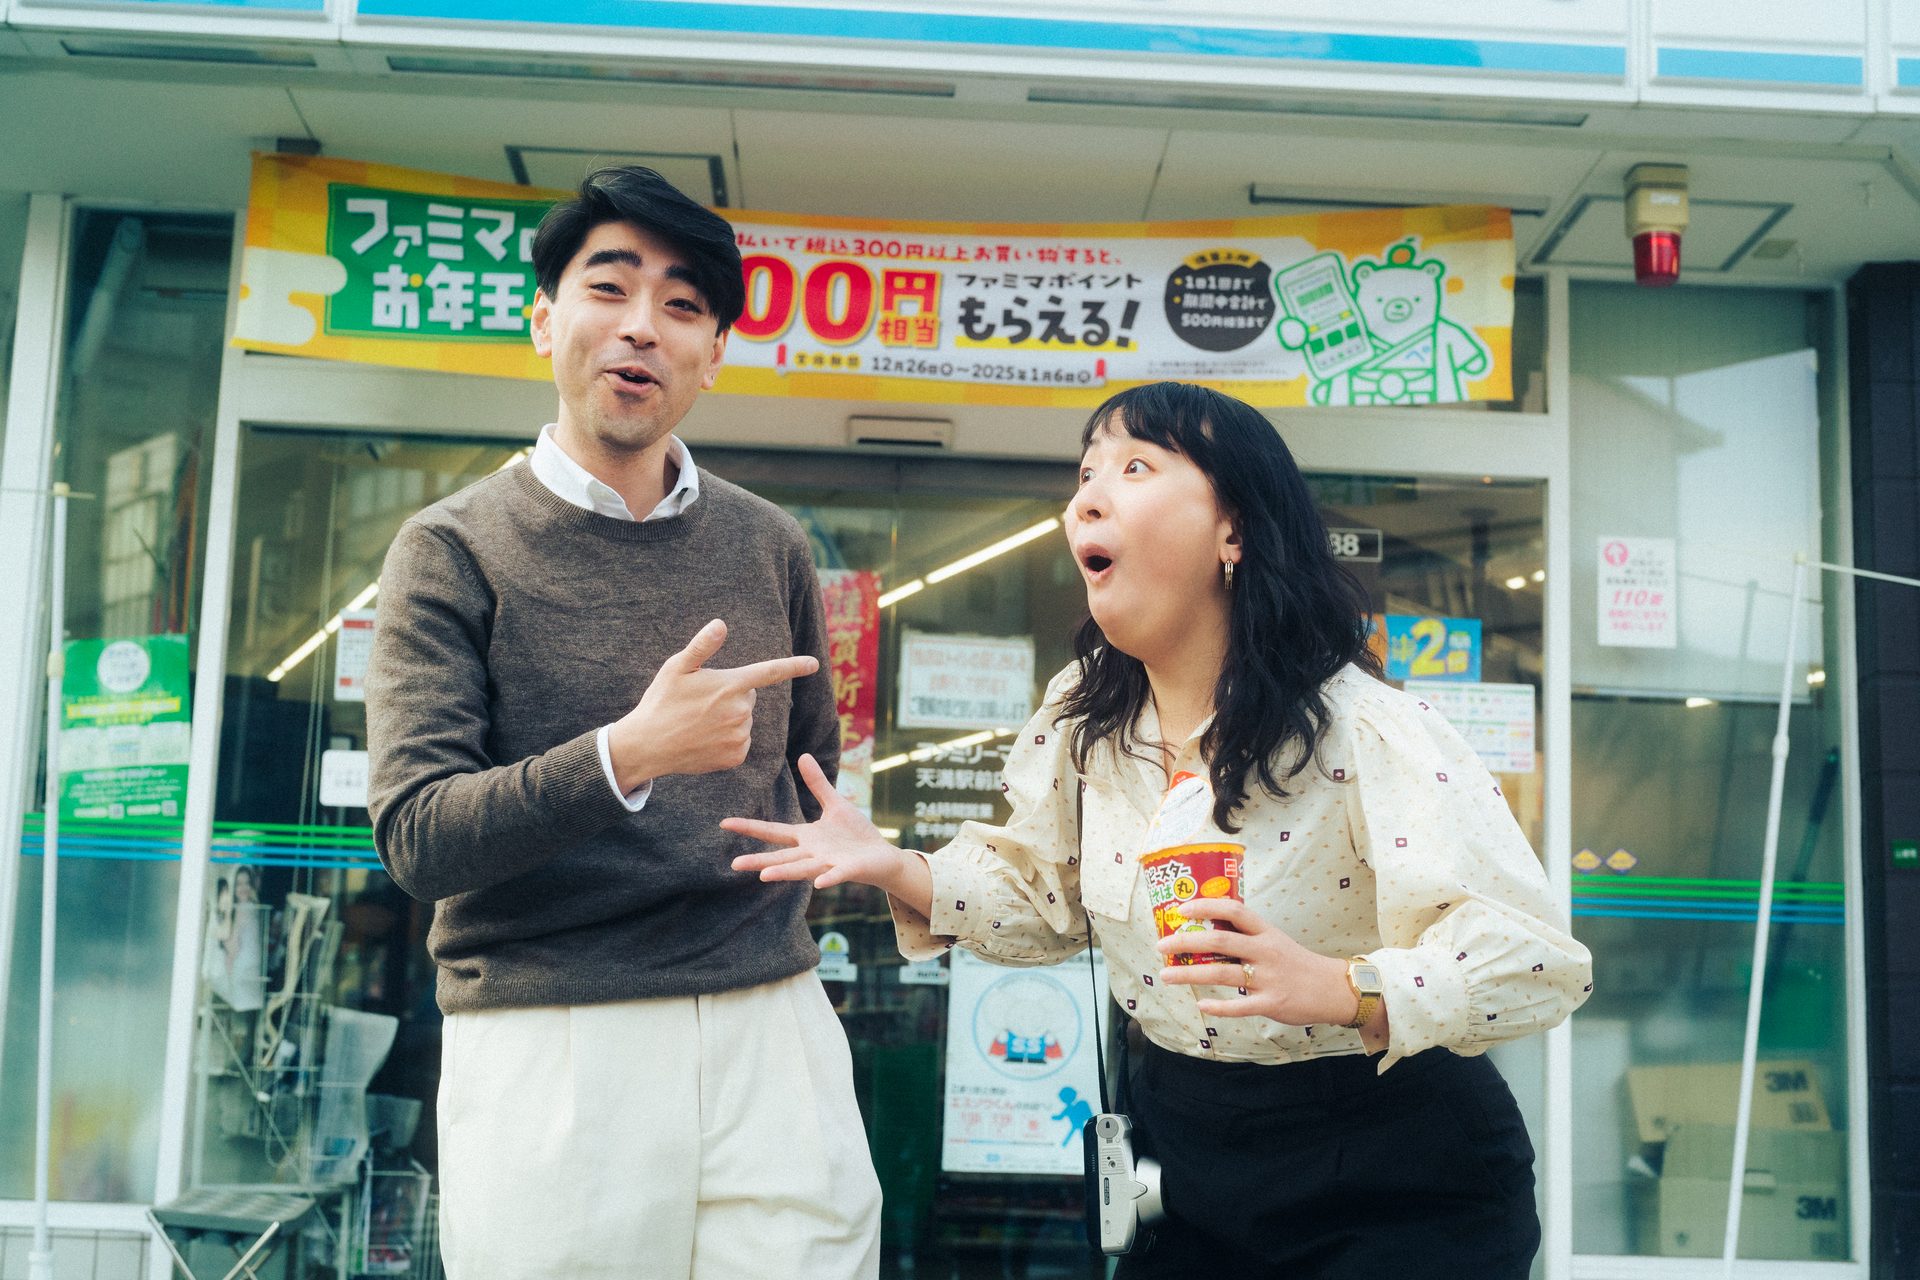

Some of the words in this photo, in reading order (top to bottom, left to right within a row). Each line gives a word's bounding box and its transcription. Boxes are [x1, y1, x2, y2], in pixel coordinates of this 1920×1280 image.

[957, 272, 1142, 289] ファミマポイント
[878, 316, 941, 346] 相当
[1764, 1071, 1808, 1092] 3M
[1797, 1196, 1836, 1220] 3M
